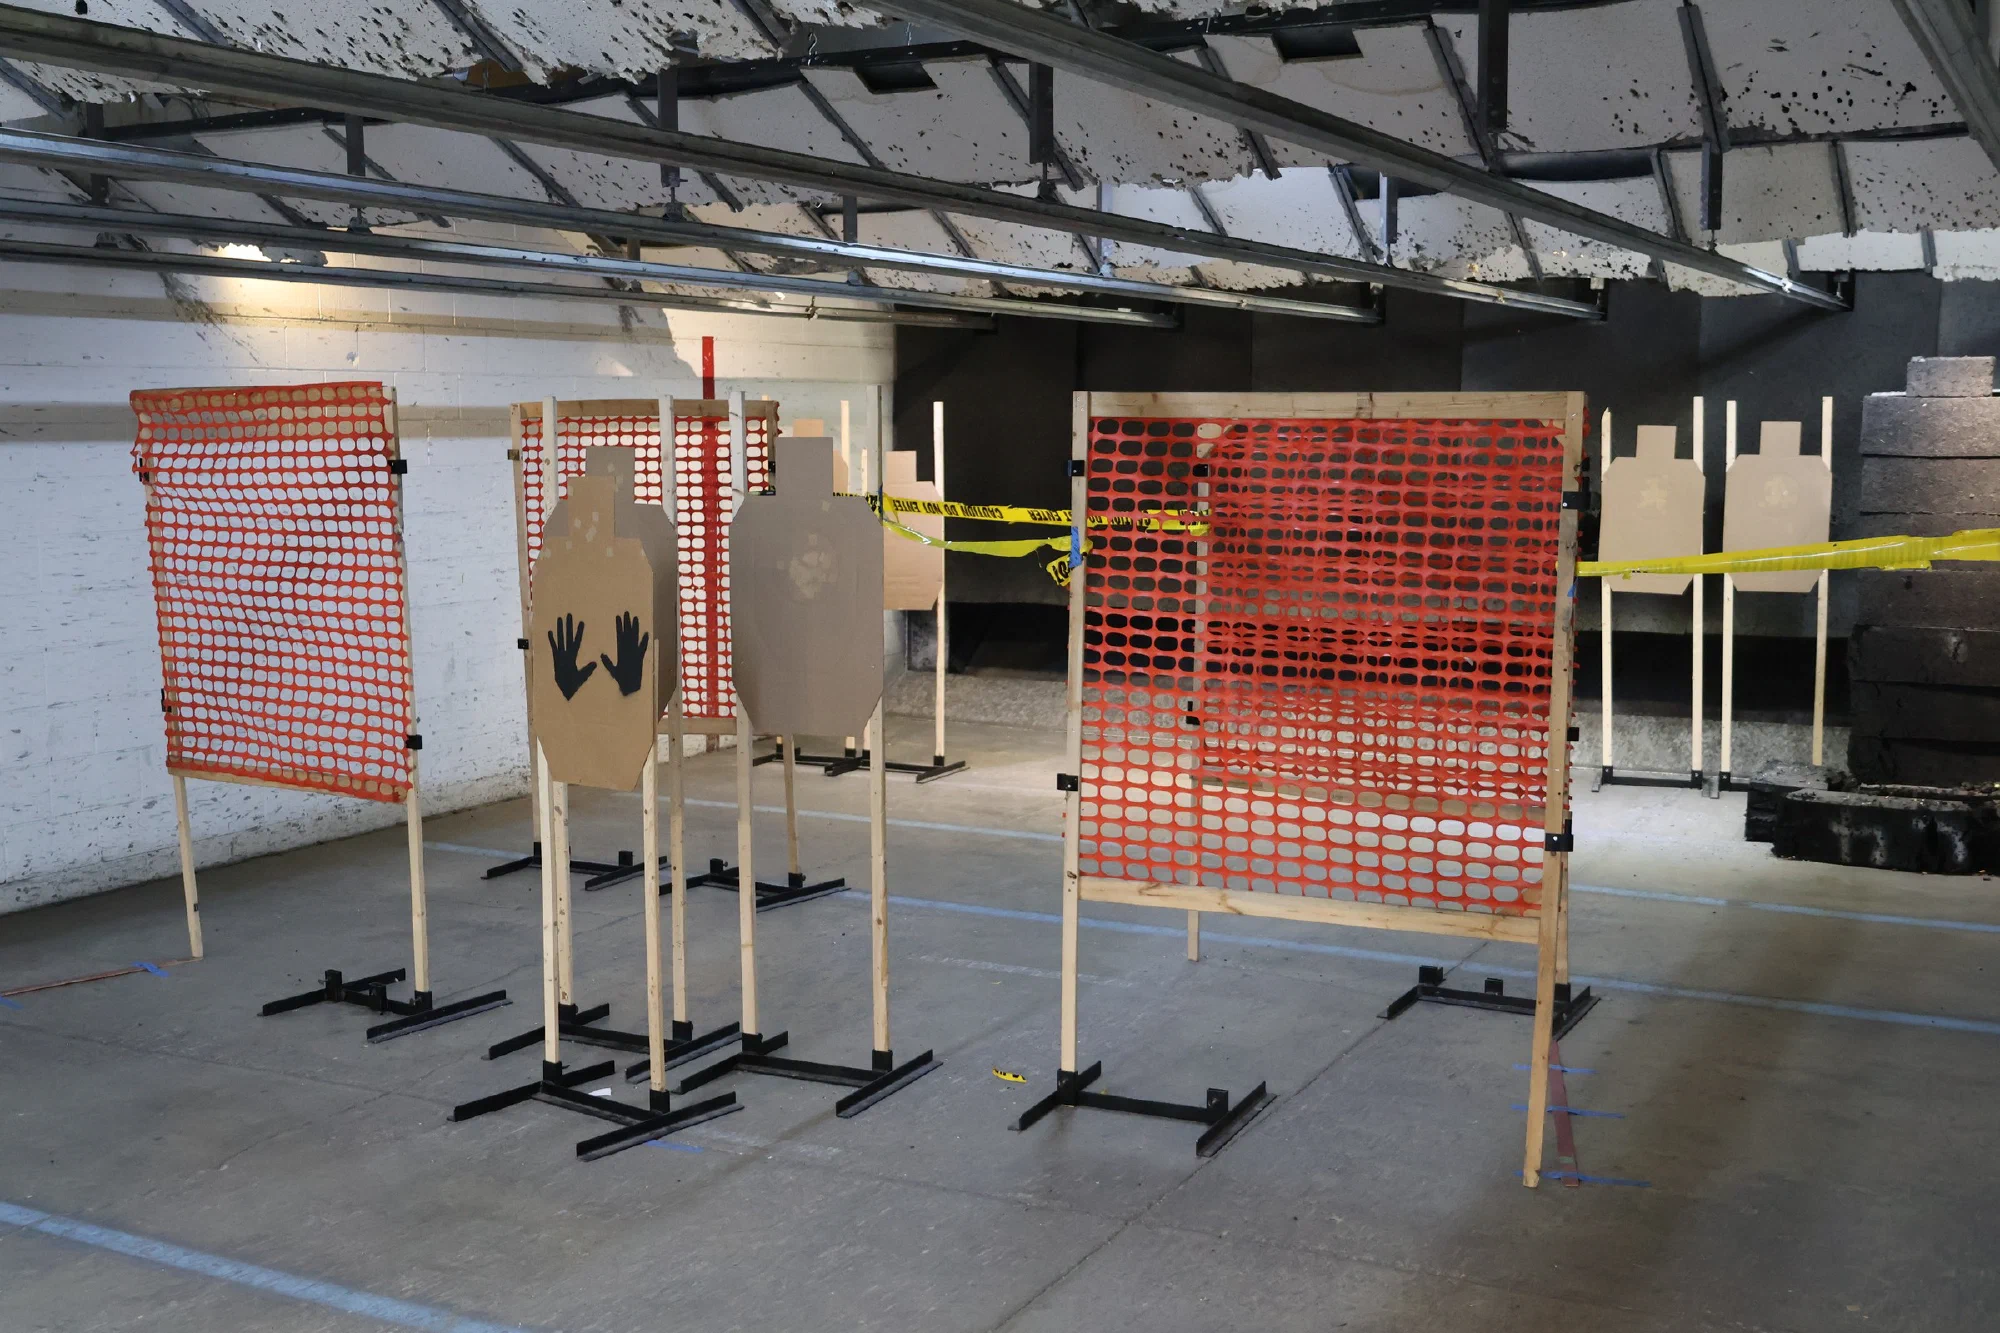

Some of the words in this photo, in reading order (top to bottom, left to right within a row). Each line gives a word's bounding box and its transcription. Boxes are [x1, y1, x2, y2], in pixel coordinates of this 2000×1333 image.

[922, 501, 944, 516] NOT
[944, 504, 960, 517] DO
[960, 505, 1004, 519] CAUTION
[1027, 509, 1063, 522] ENTER
